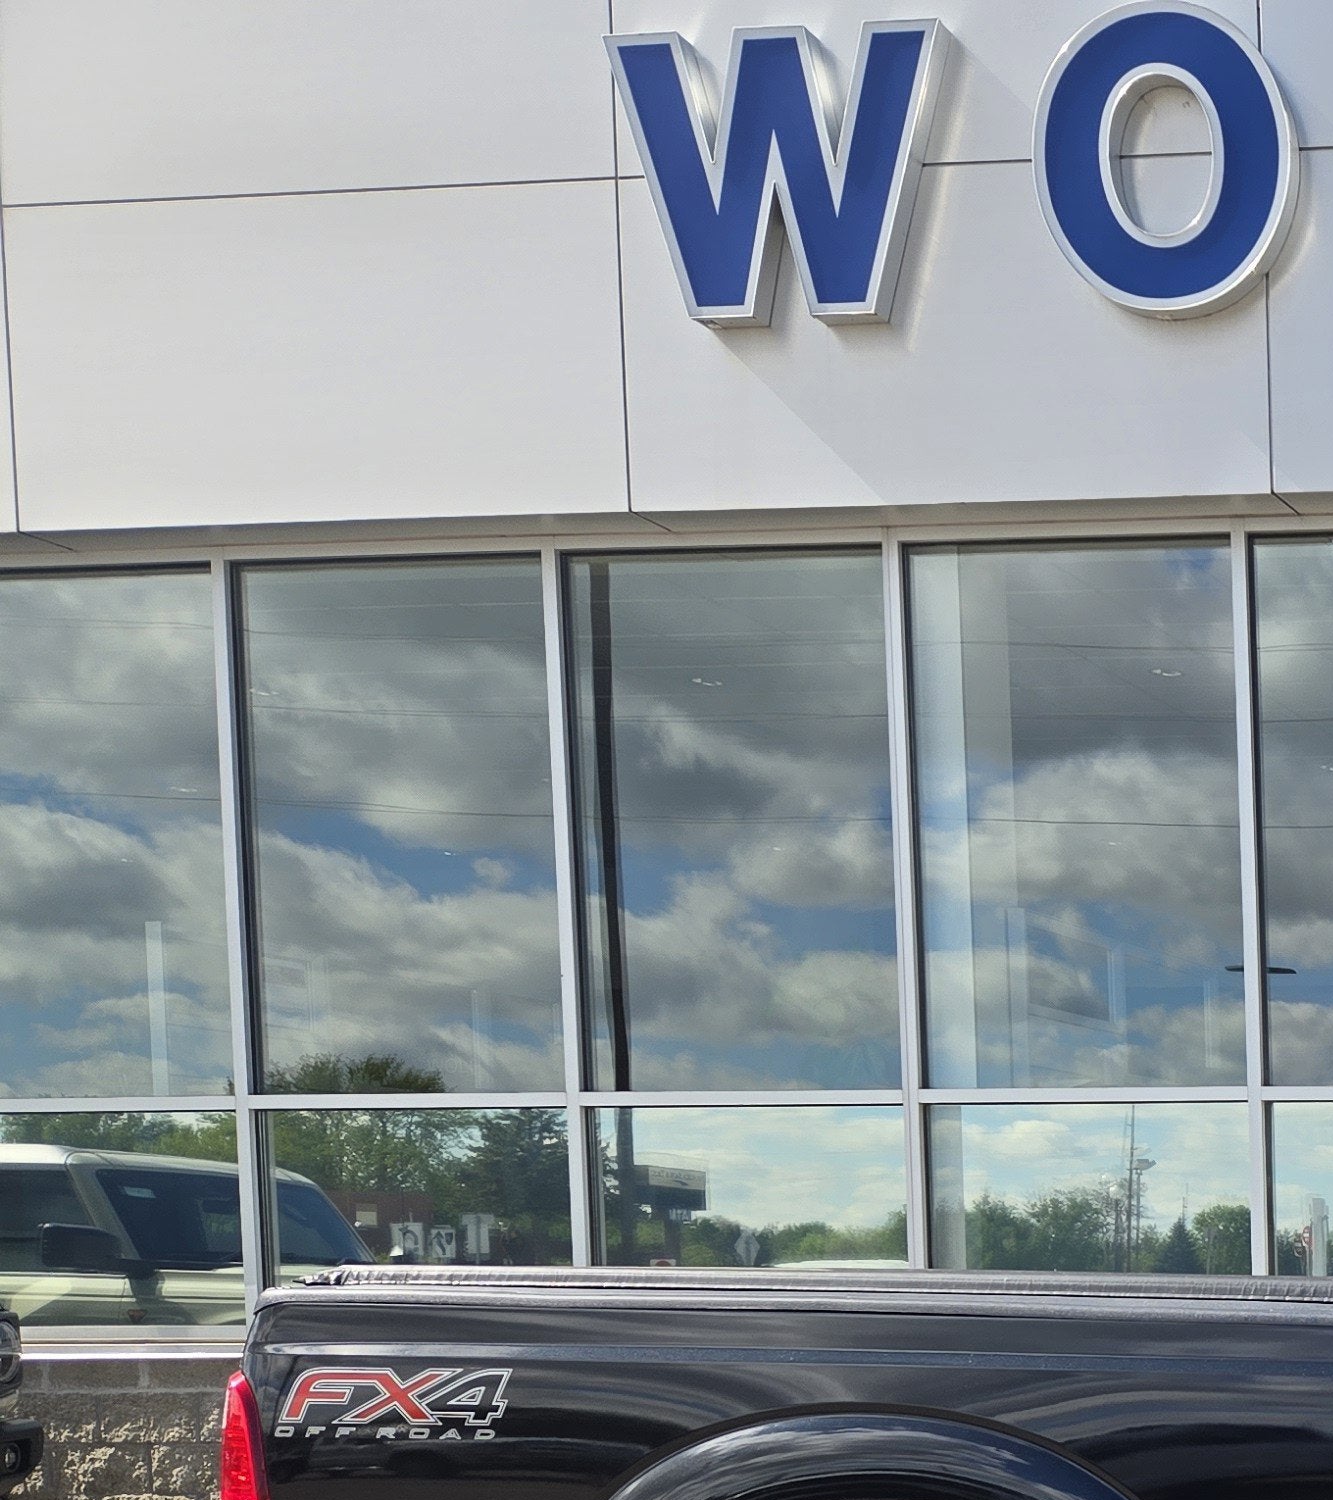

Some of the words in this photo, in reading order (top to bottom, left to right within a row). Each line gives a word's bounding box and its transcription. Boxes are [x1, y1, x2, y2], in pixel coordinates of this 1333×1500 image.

[278, 1366, 513, 1427] FX4
[274, 1426, 357, 1439] OFF
[375, 1426, 496, 1440] ROAD
